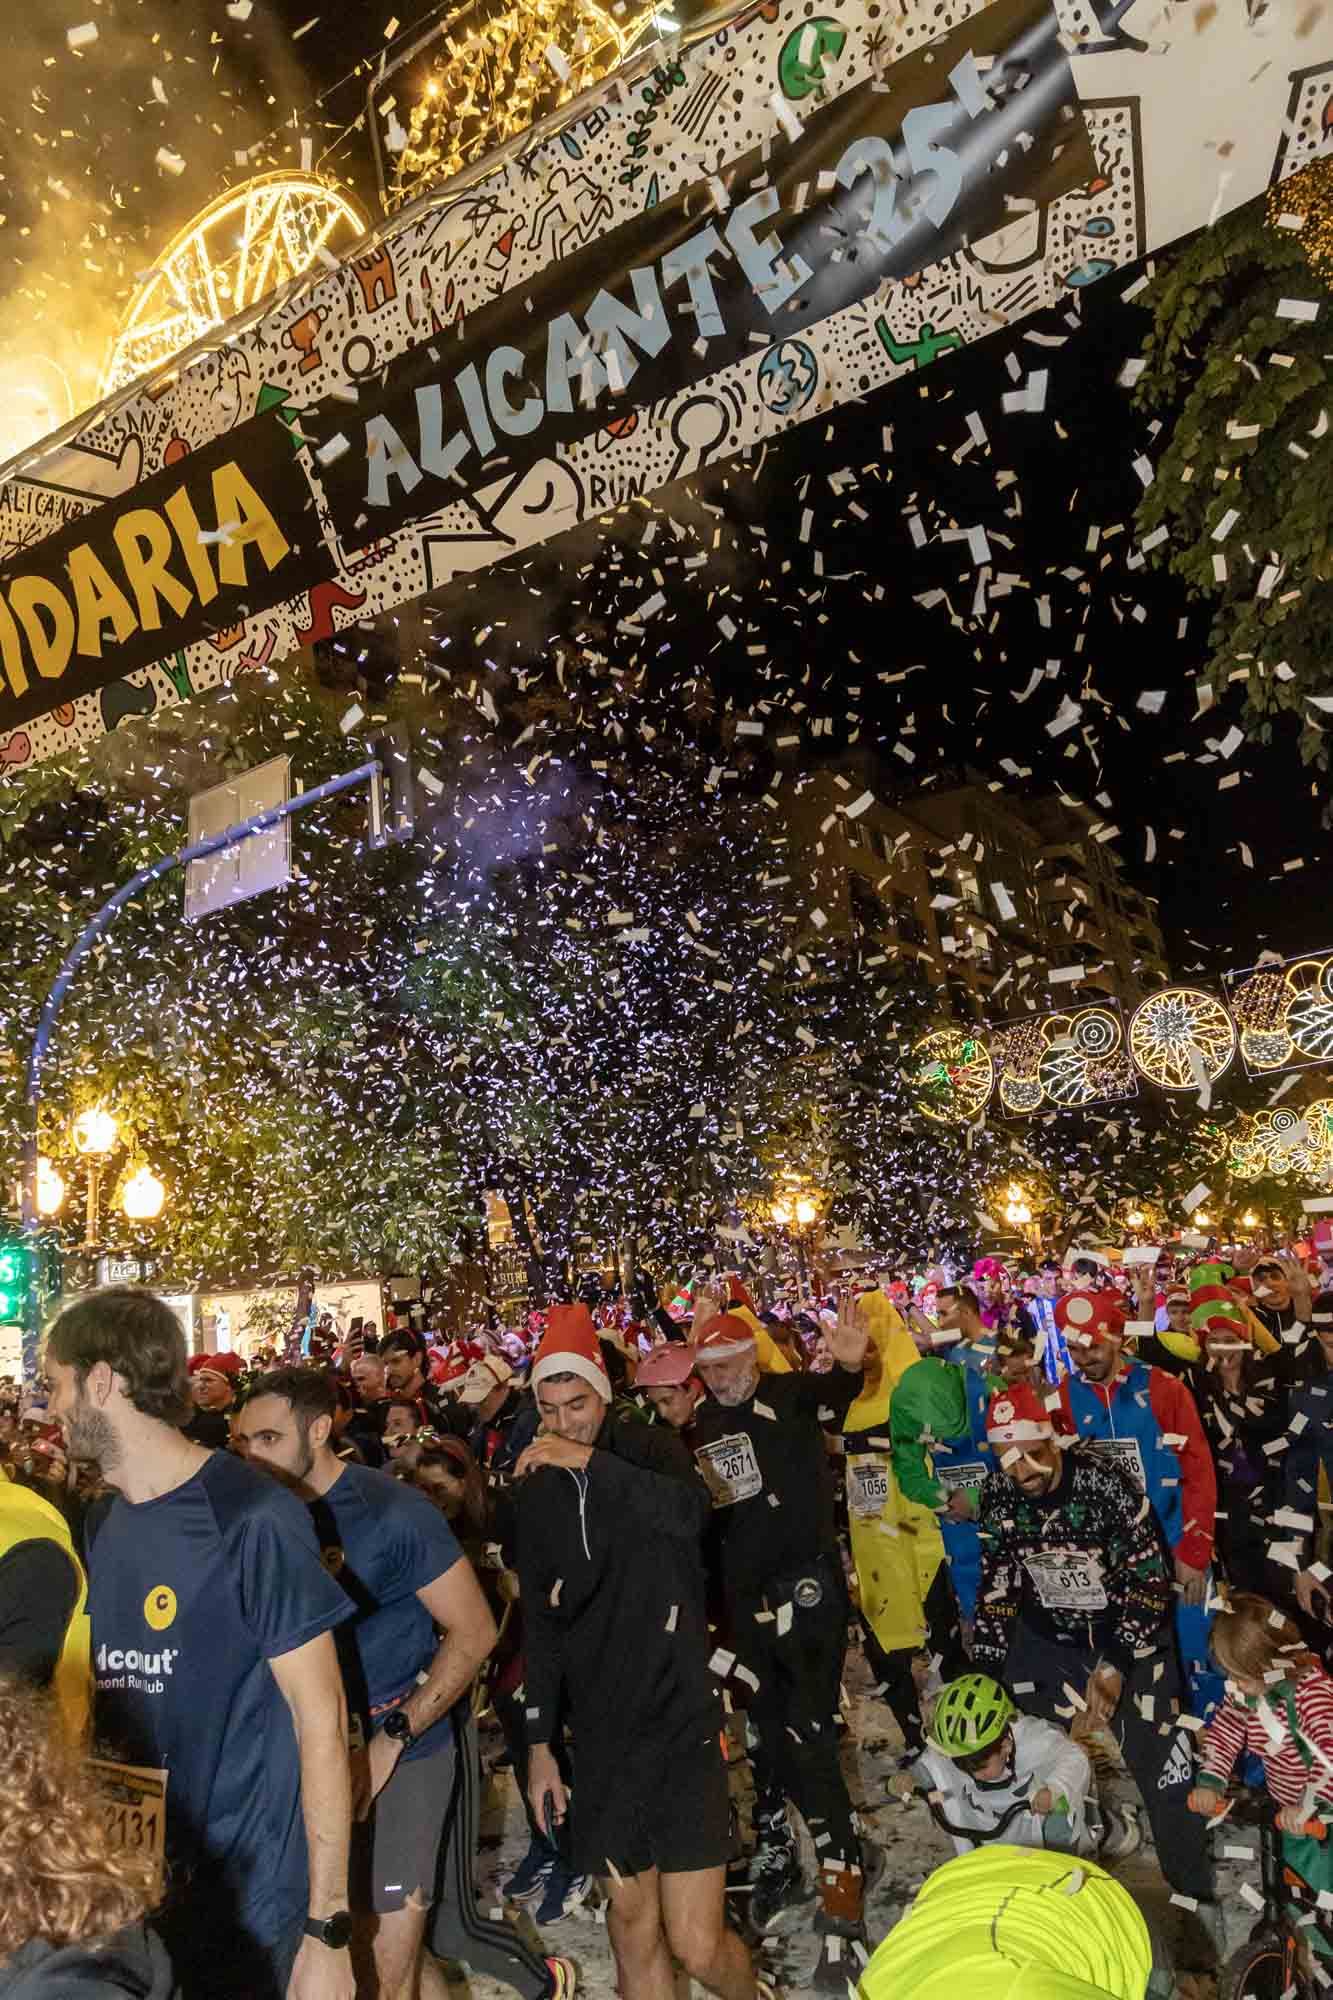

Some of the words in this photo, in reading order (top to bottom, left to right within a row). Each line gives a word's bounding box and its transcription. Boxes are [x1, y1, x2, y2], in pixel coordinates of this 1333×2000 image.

[0, 461, 289, 698] IDARIA
[364, 186, 814, 506] ALICANTE
[590, 472, 647, 508] RUN
[722, 1452, 754, 1479] 2671
[862, 1479, 888, 1497] 1056
[1060, 1571, 1090, 1588] 613
